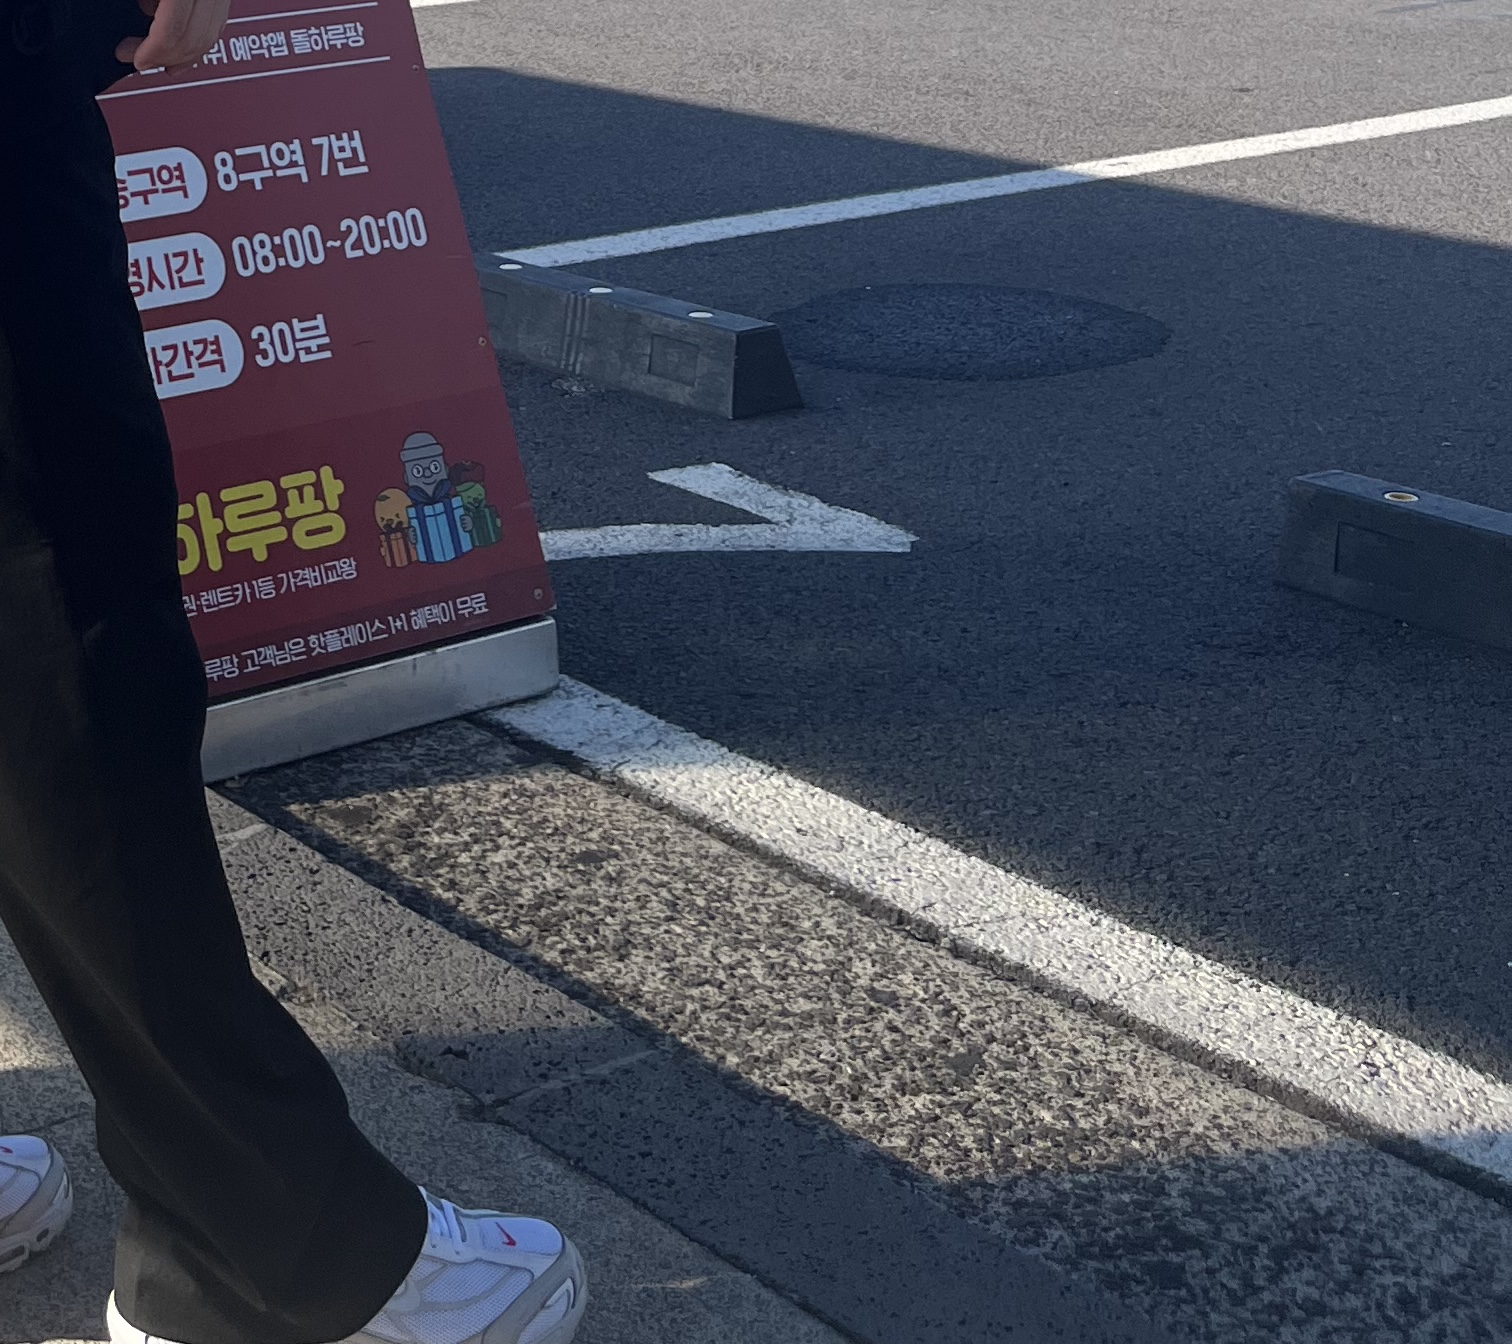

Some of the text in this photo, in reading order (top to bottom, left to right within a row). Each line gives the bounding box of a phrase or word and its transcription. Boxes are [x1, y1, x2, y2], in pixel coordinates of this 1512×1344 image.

[231, 30, 290, 62] 예약앱
[290, 22, 366, 56] 돌하루팡
[213, 136, 310, 193] 8구역
[311, 129, 370, 178] 7번
[231, 206, 429, 279] 08:00~20:00
[149, 313, 333, 386] 간격 30분
[251, 575, 277, 600] 1등
[277, 557, 358, 594] 가격비교왕
[241, 637, 308, 673] 고객님은
[307, 617, 389, 657] 핫플레이스
[389, 615, 410, 637] 1+1
[410, 600, 455, 632] 혜택이
[455, 591, 489, 619] 무료
